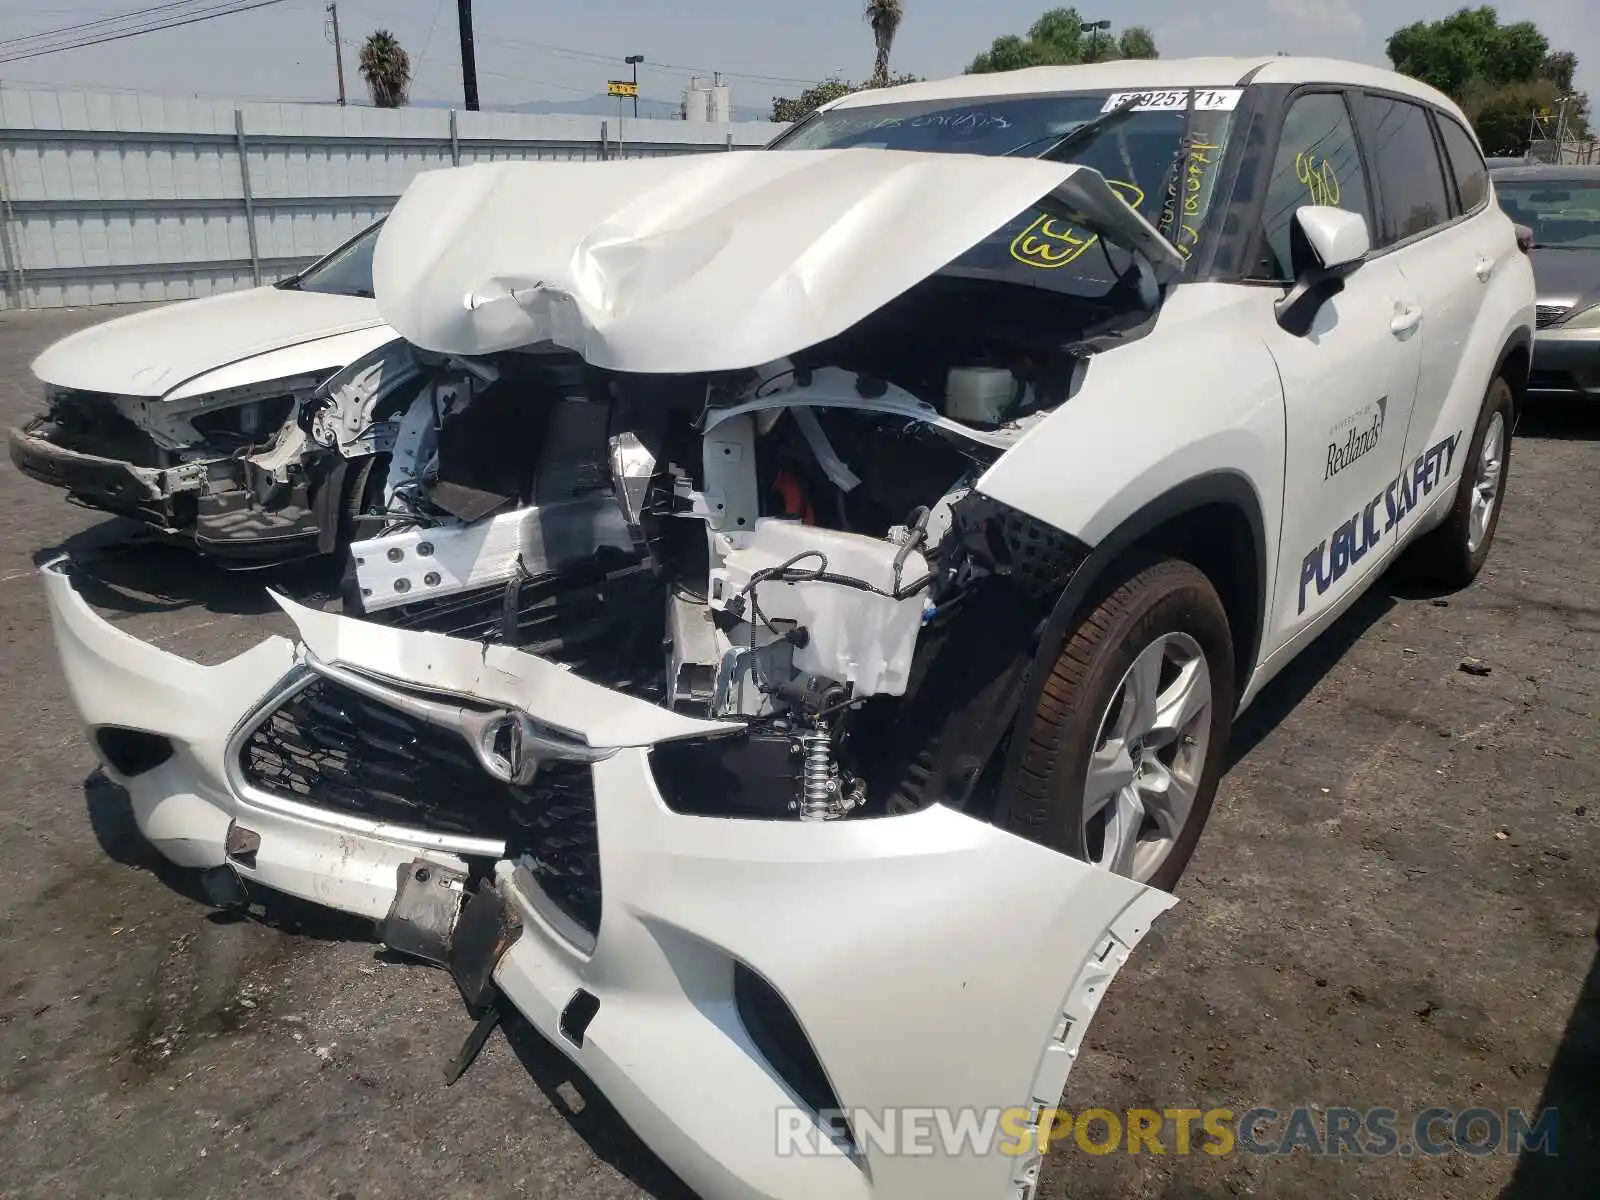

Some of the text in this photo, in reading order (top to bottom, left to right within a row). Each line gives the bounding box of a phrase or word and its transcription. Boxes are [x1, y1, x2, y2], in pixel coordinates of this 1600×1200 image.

[1324, 413, 1381, 481] Redlands
[1297, 429, 1463, 616] PUBLIC SAFETY
